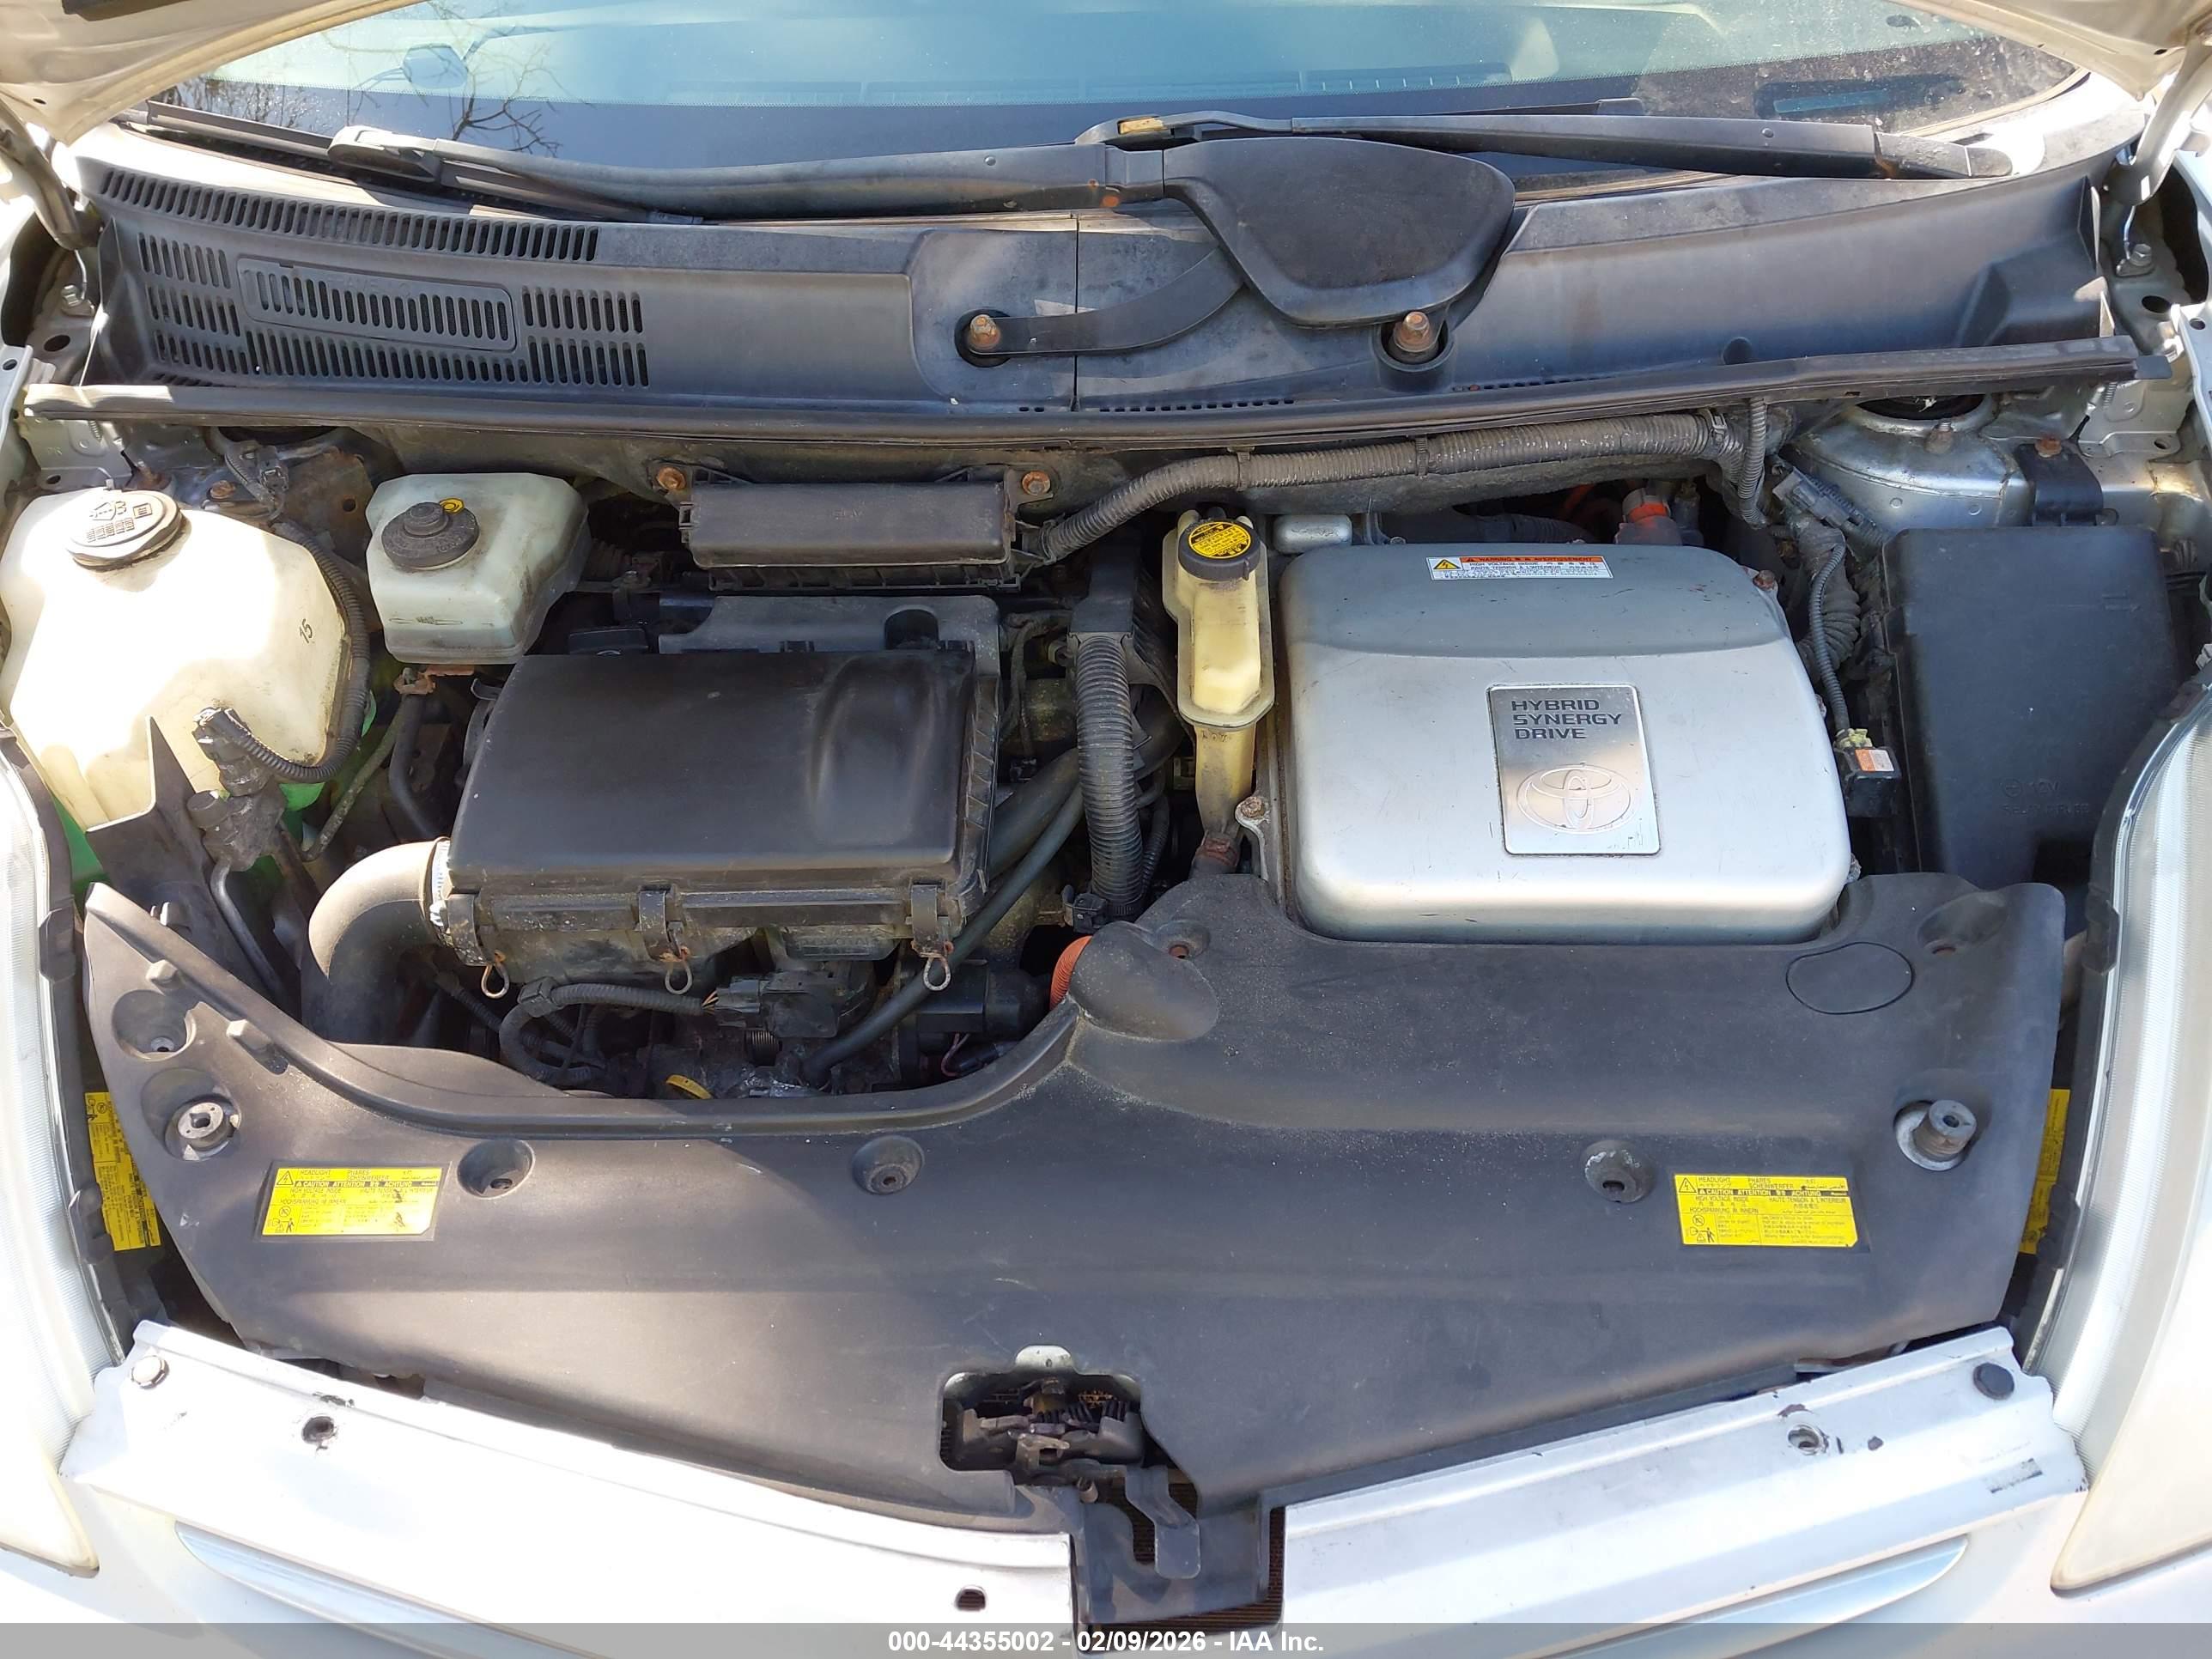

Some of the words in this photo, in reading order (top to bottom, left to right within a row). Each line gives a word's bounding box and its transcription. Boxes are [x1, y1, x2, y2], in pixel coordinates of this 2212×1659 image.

[1511, 700, 1600, 711] HYBRID
[1513, 714, 1622, 726] SYNERGY
[1516, 728, 1587, 739] DRIVE
